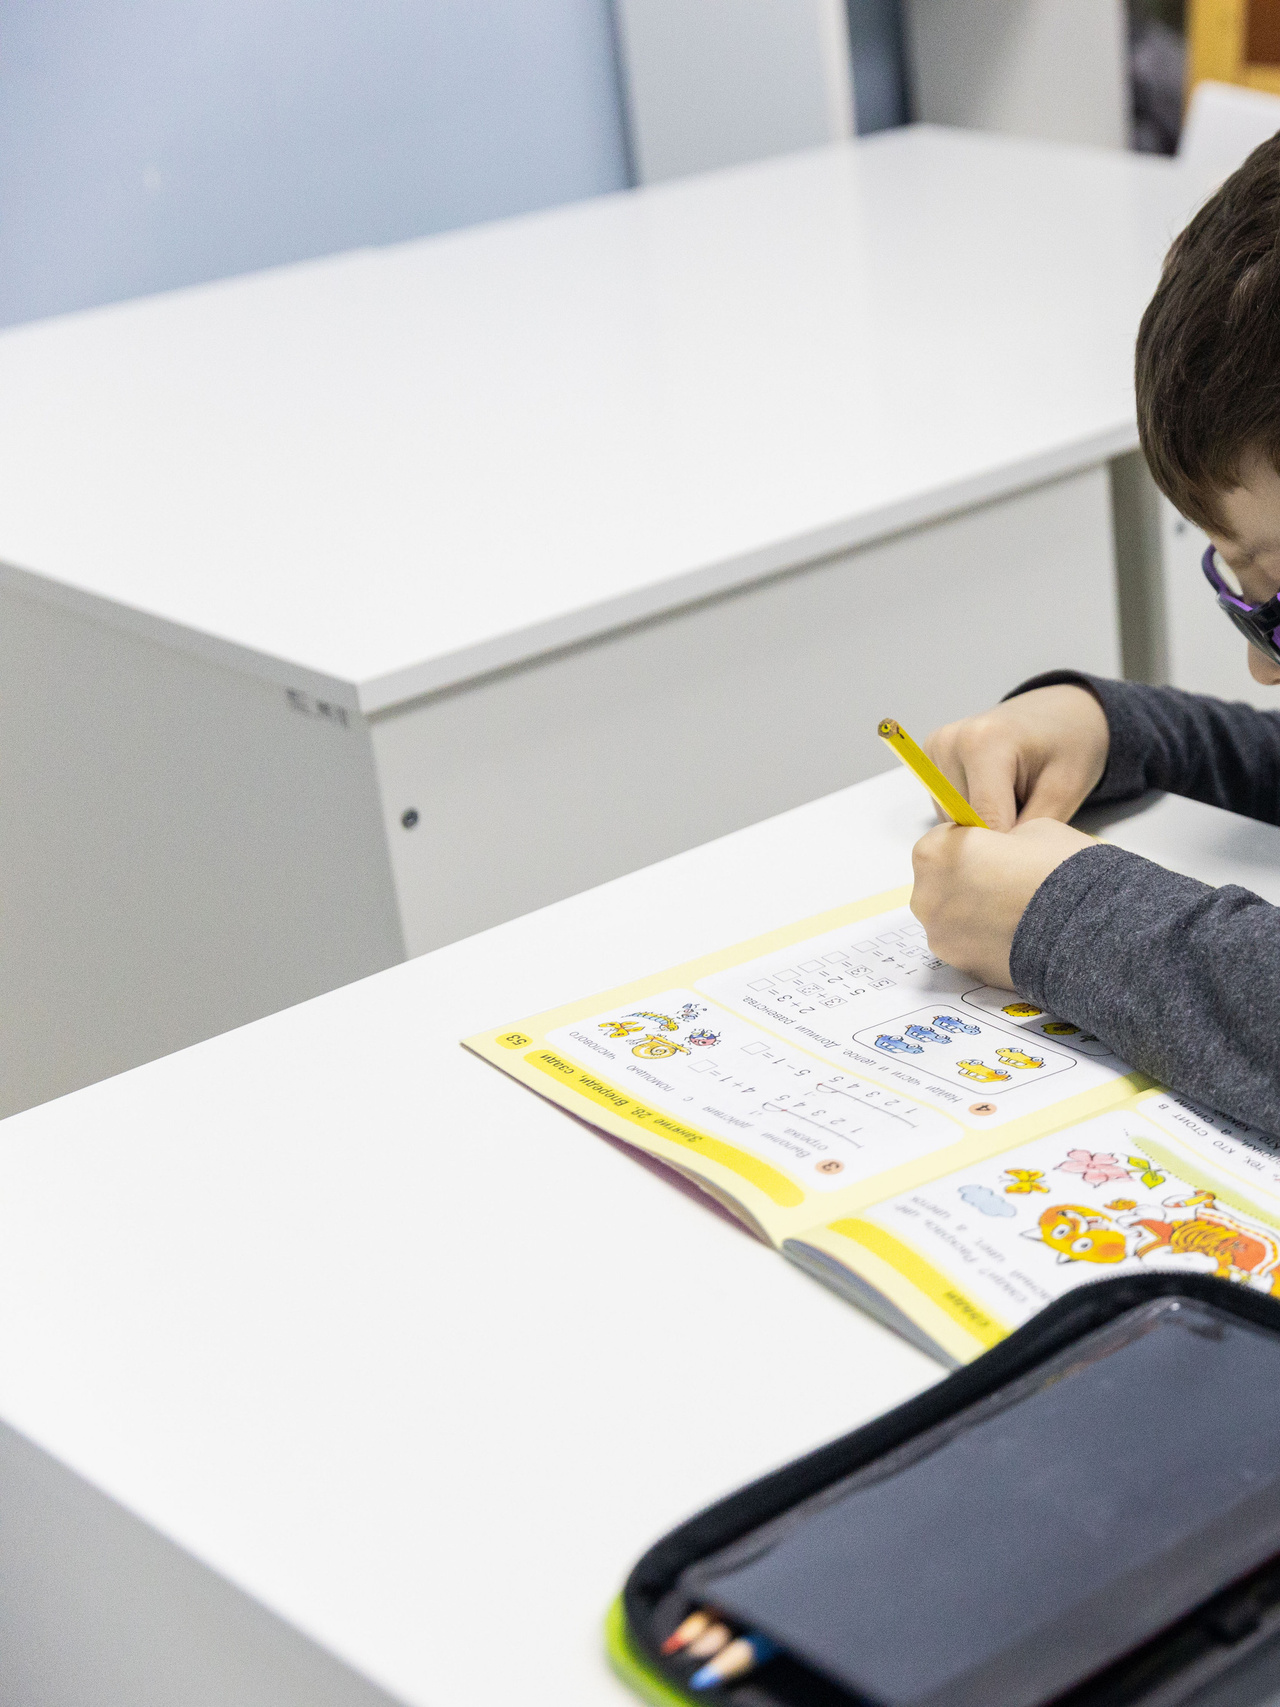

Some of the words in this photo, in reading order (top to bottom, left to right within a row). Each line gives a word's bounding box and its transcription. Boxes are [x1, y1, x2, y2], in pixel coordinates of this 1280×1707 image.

[742, 994, 796, 1025] равенства.
[505, 1032, 528, 1047] 53
[568, 1030, 618, 1061] числового
[795, 1025, 842, 1050] Допиши
[539, 1053, 576, 1076] сзади
[842, 1048, 877, 1067] целое.
[878, 1064, 889, 1072] и
[626, 1064, 676, 1093] помощью
[891, 1067, 921, 1086] части
[579, 1074, 629, 1108] Впереди,
[925, 1084, 965, 1103] Найди
[630, 1105, 654, 1120] 28.
[701, 1104, 756, 1130] действия
[974, 1104, 991, 1112] 4
[1174, 1097, 1215, 1125] синим
[653, 1117, 704, 1144] Занятие
[1171, 1112, 1209, 1137] стоит
[1220, 1127, 1233, 1136] а
[760, 1131, 811, 1159] Выполни
[782, 1126, 829, 1151] отрезка.
[1212, 1139, 1236, 1155] кто
[821, 1161, 841, 1172] 3
